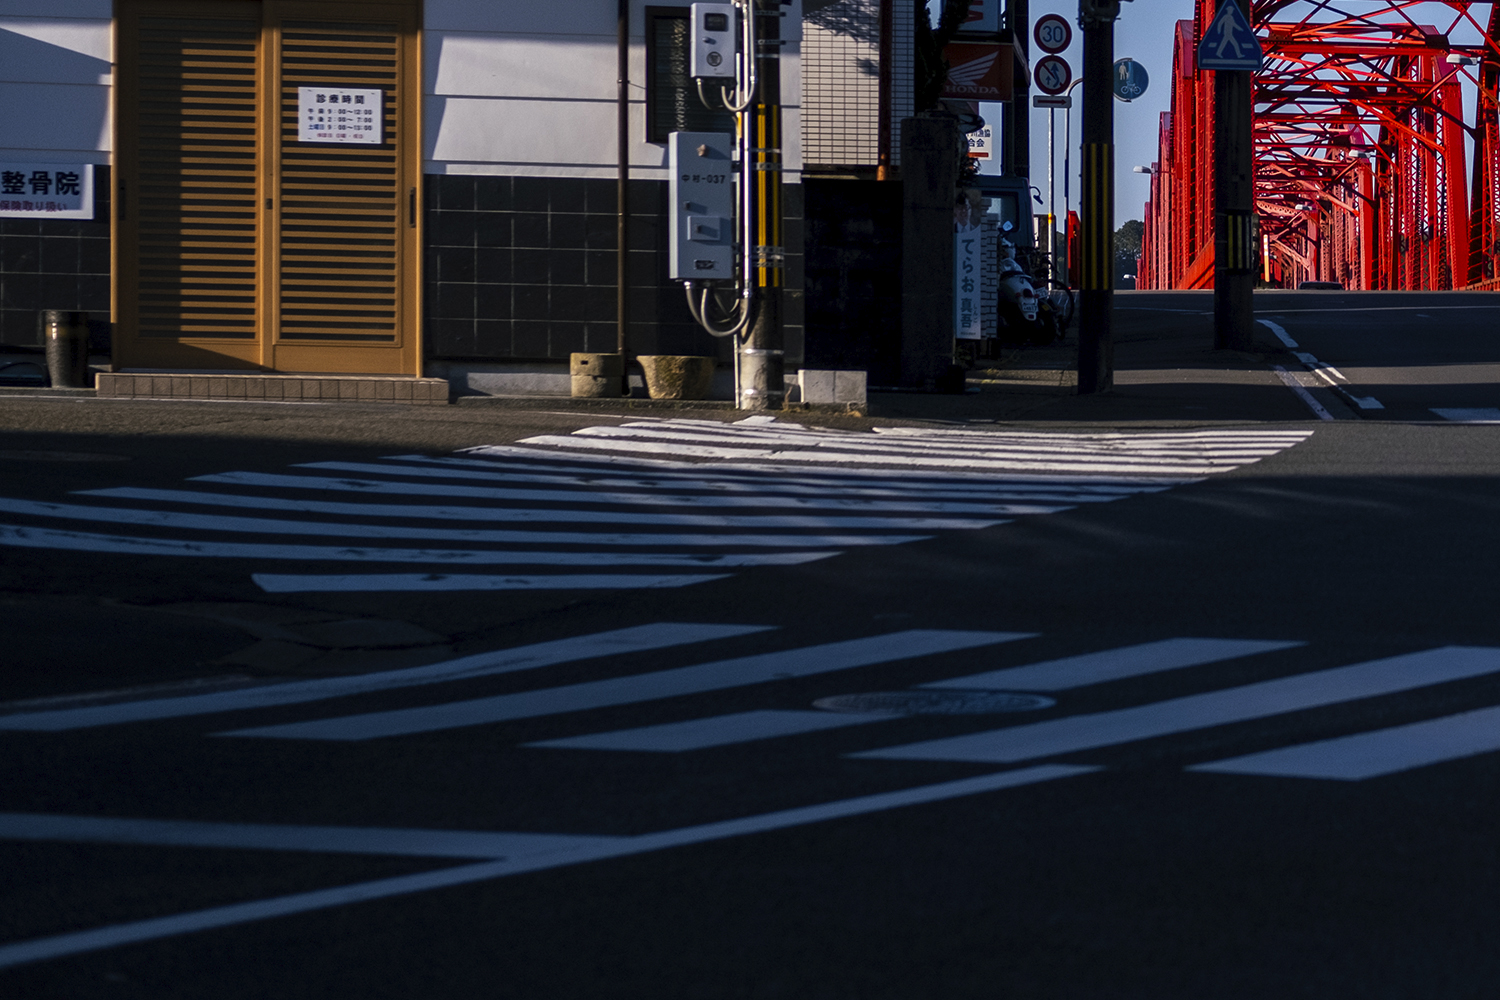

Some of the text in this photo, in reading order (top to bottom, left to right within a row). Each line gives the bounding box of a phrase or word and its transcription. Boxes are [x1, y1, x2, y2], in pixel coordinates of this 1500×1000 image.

[1042, 25, 1063, 43] 30
[945, 84, 1000, 95] HONDA
[316, 93, 365, 104] 診療時間
[1, 170, 80, 195] 整骨院
